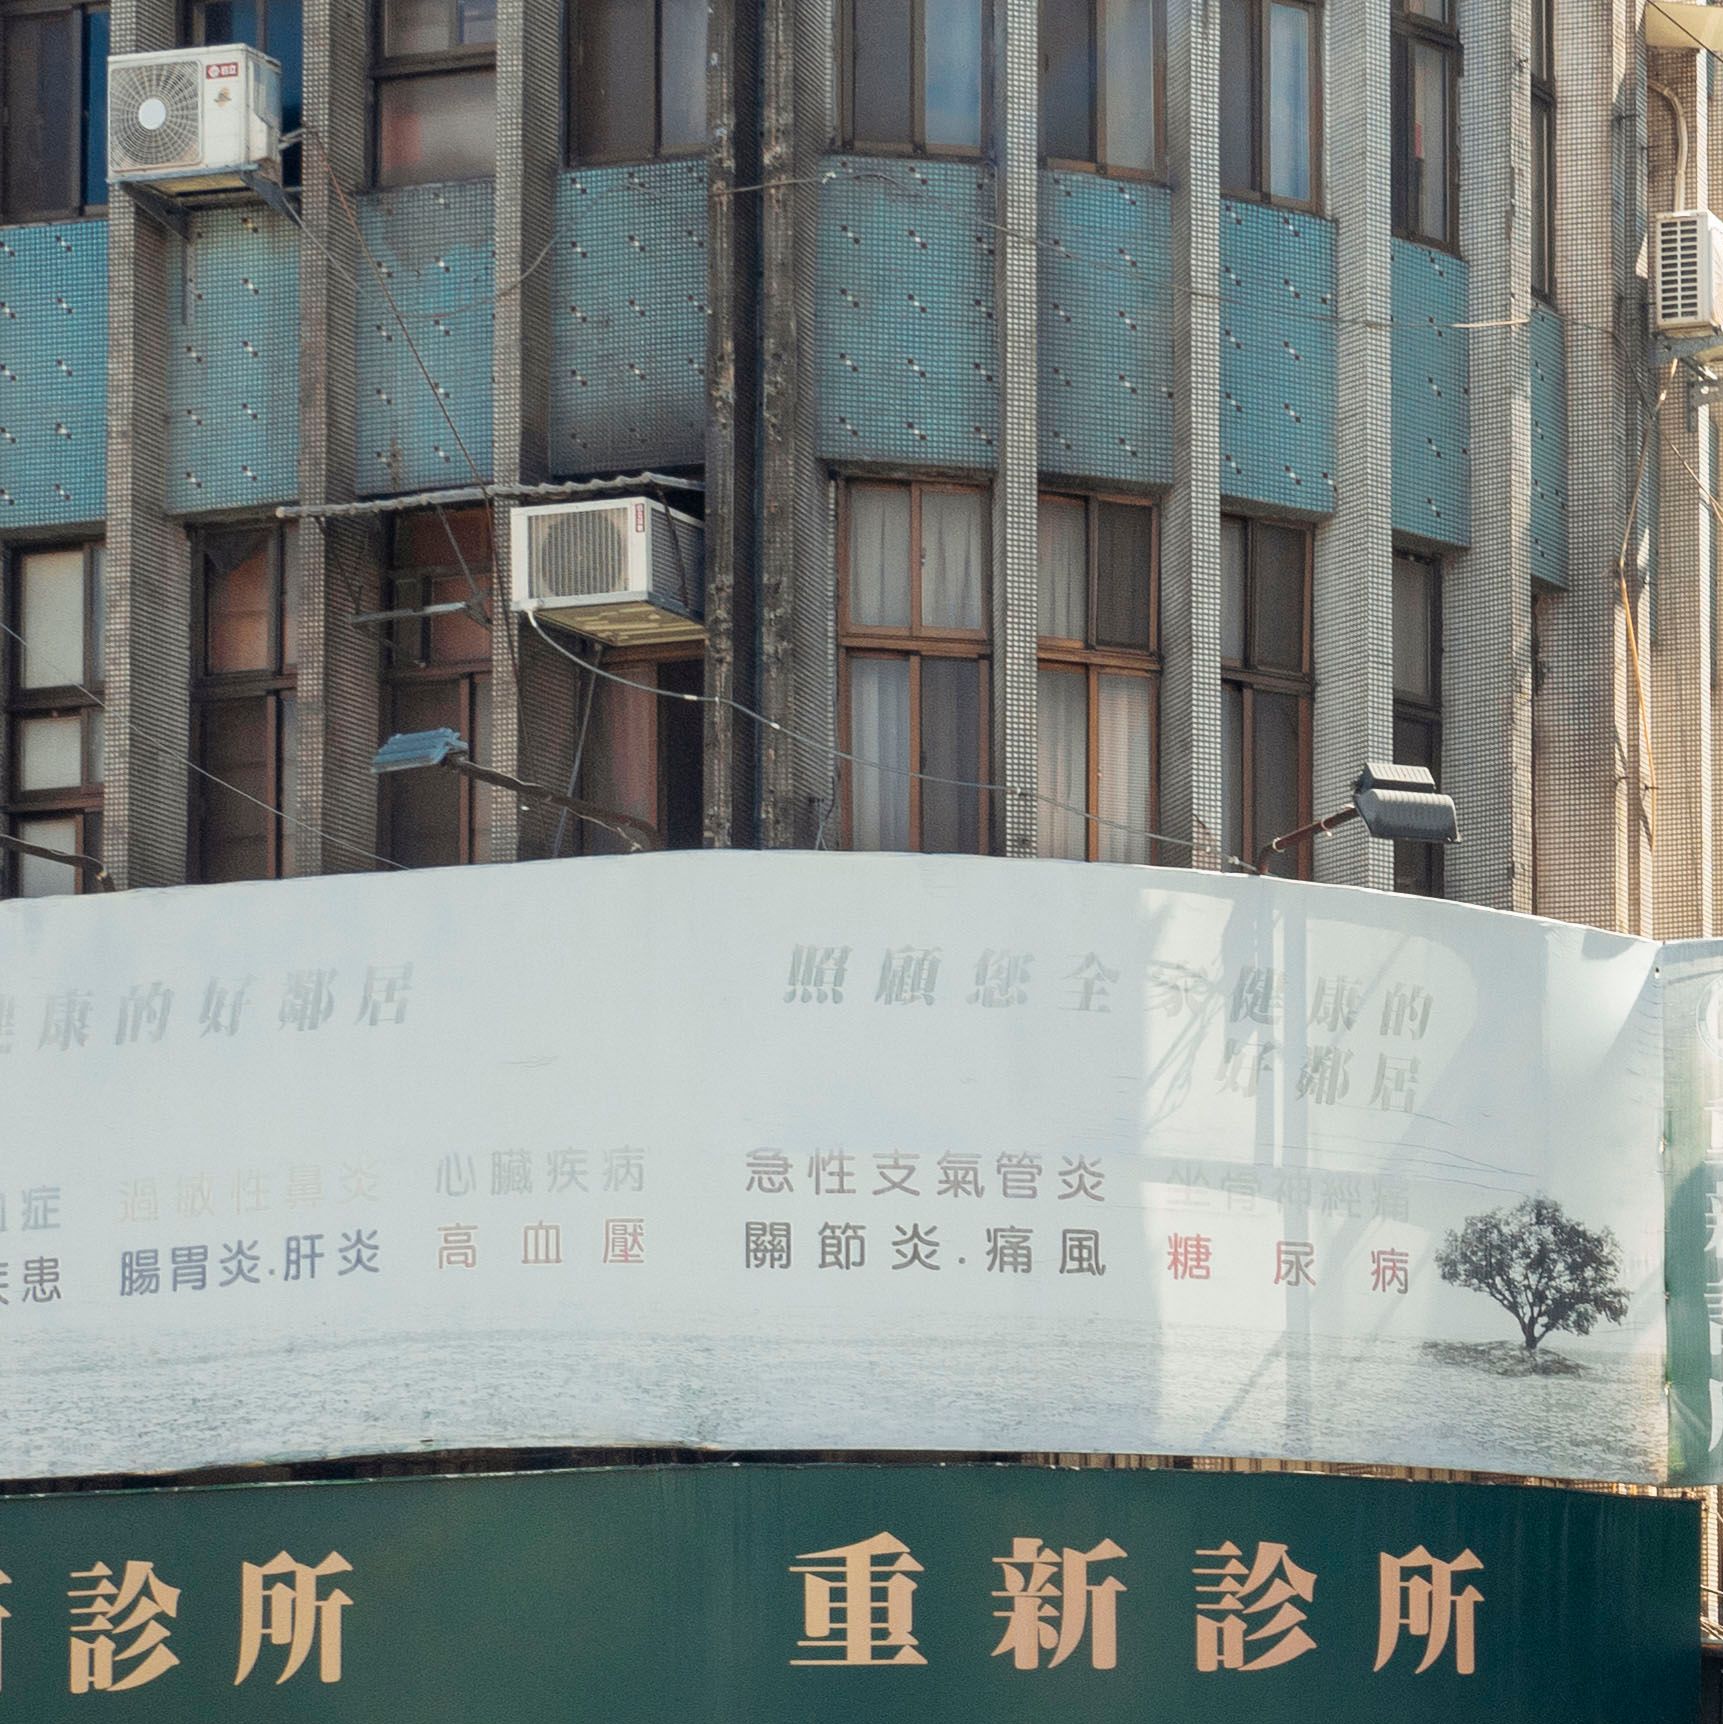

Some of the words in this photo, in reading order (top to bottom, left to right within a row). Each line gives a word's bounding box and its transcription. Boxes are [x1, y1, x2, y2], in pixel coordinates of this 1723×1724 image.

[435, 1145, 646, 1197] 心臟疾病
[744, 1147, 1108, 1204] 急性支氣管炎
[436, 1217, 646, 1270] 高血壓
[1165, 1231, 1410, 1294] 糖尿病
[0, 1548, 354, 1696] 診所
[789, 1531, 1486, 1676] 重新診所
